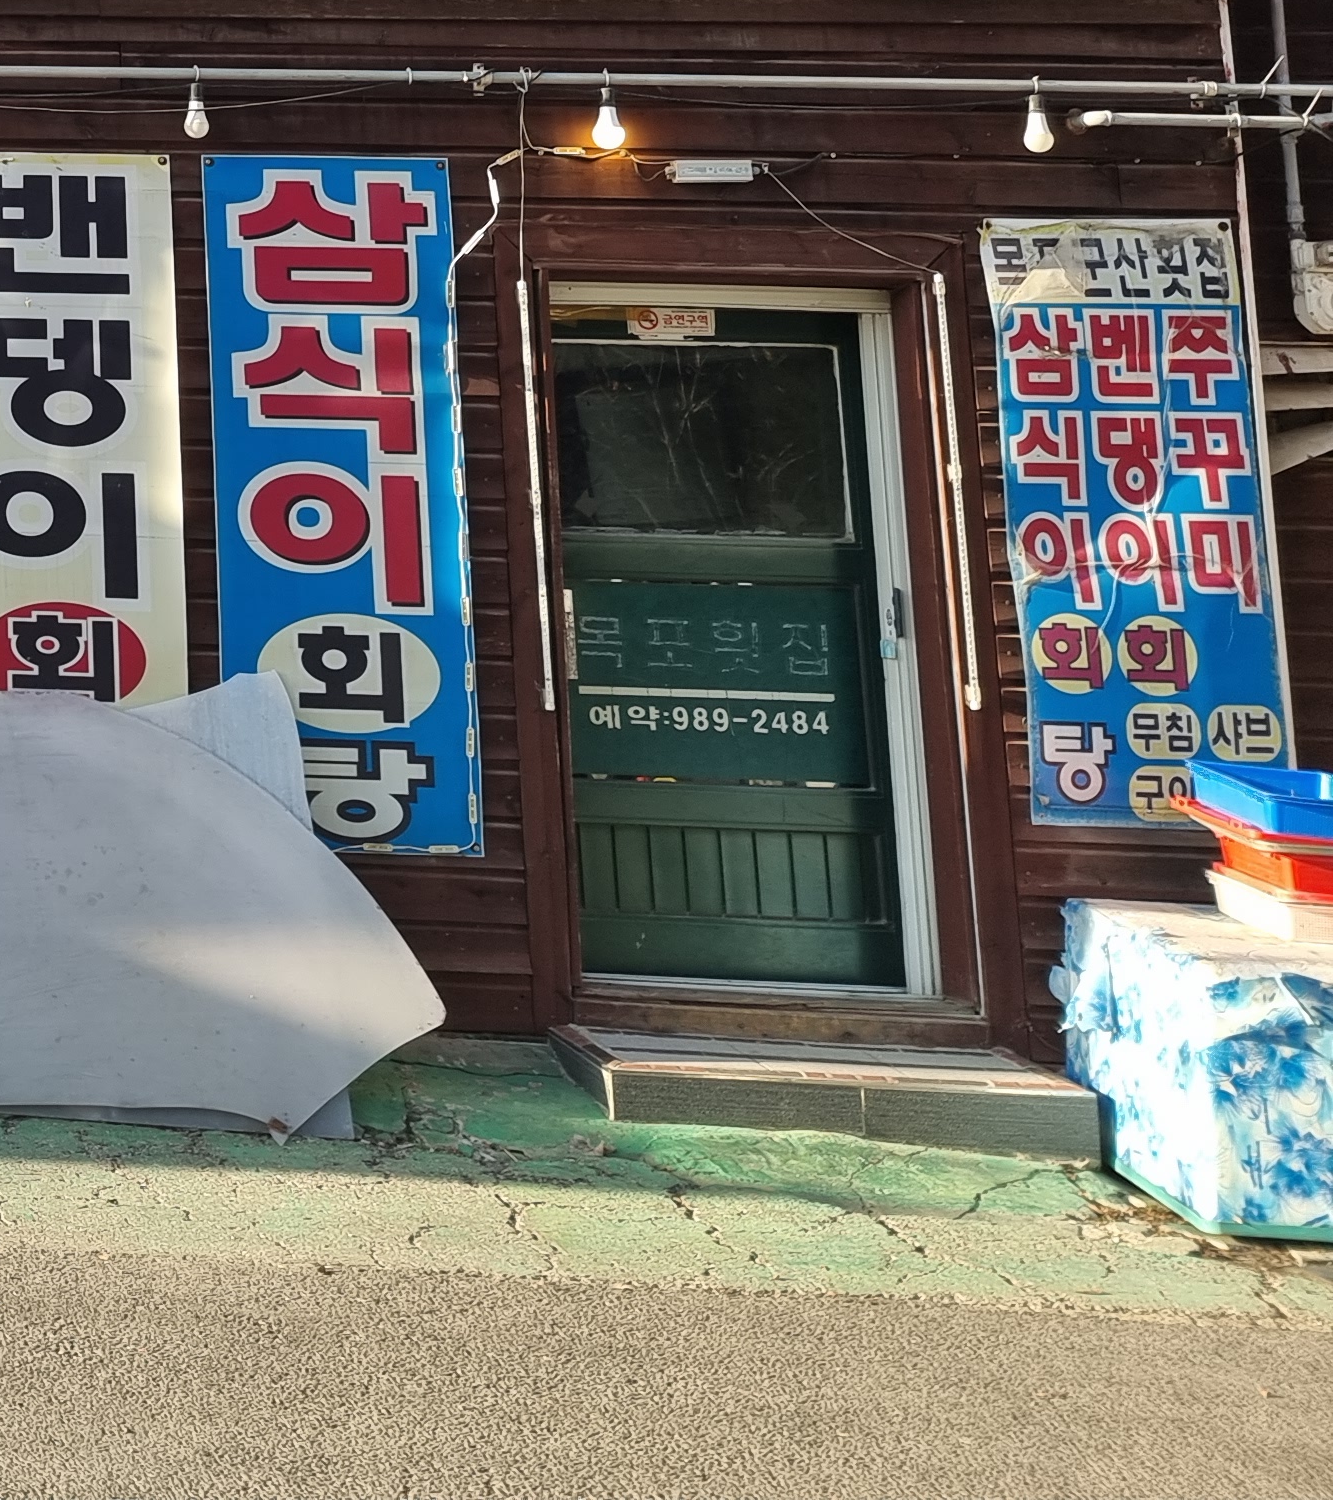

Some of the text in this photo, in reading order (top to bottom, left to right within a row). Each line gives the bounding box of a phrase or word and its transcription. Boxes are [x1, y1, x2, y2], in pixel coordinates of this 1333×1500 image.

[662, 314, 708, 326] 금연구역
[1132, 710, 1194, 753] 무침
[1212, 712, 1274, 754] 샤브
